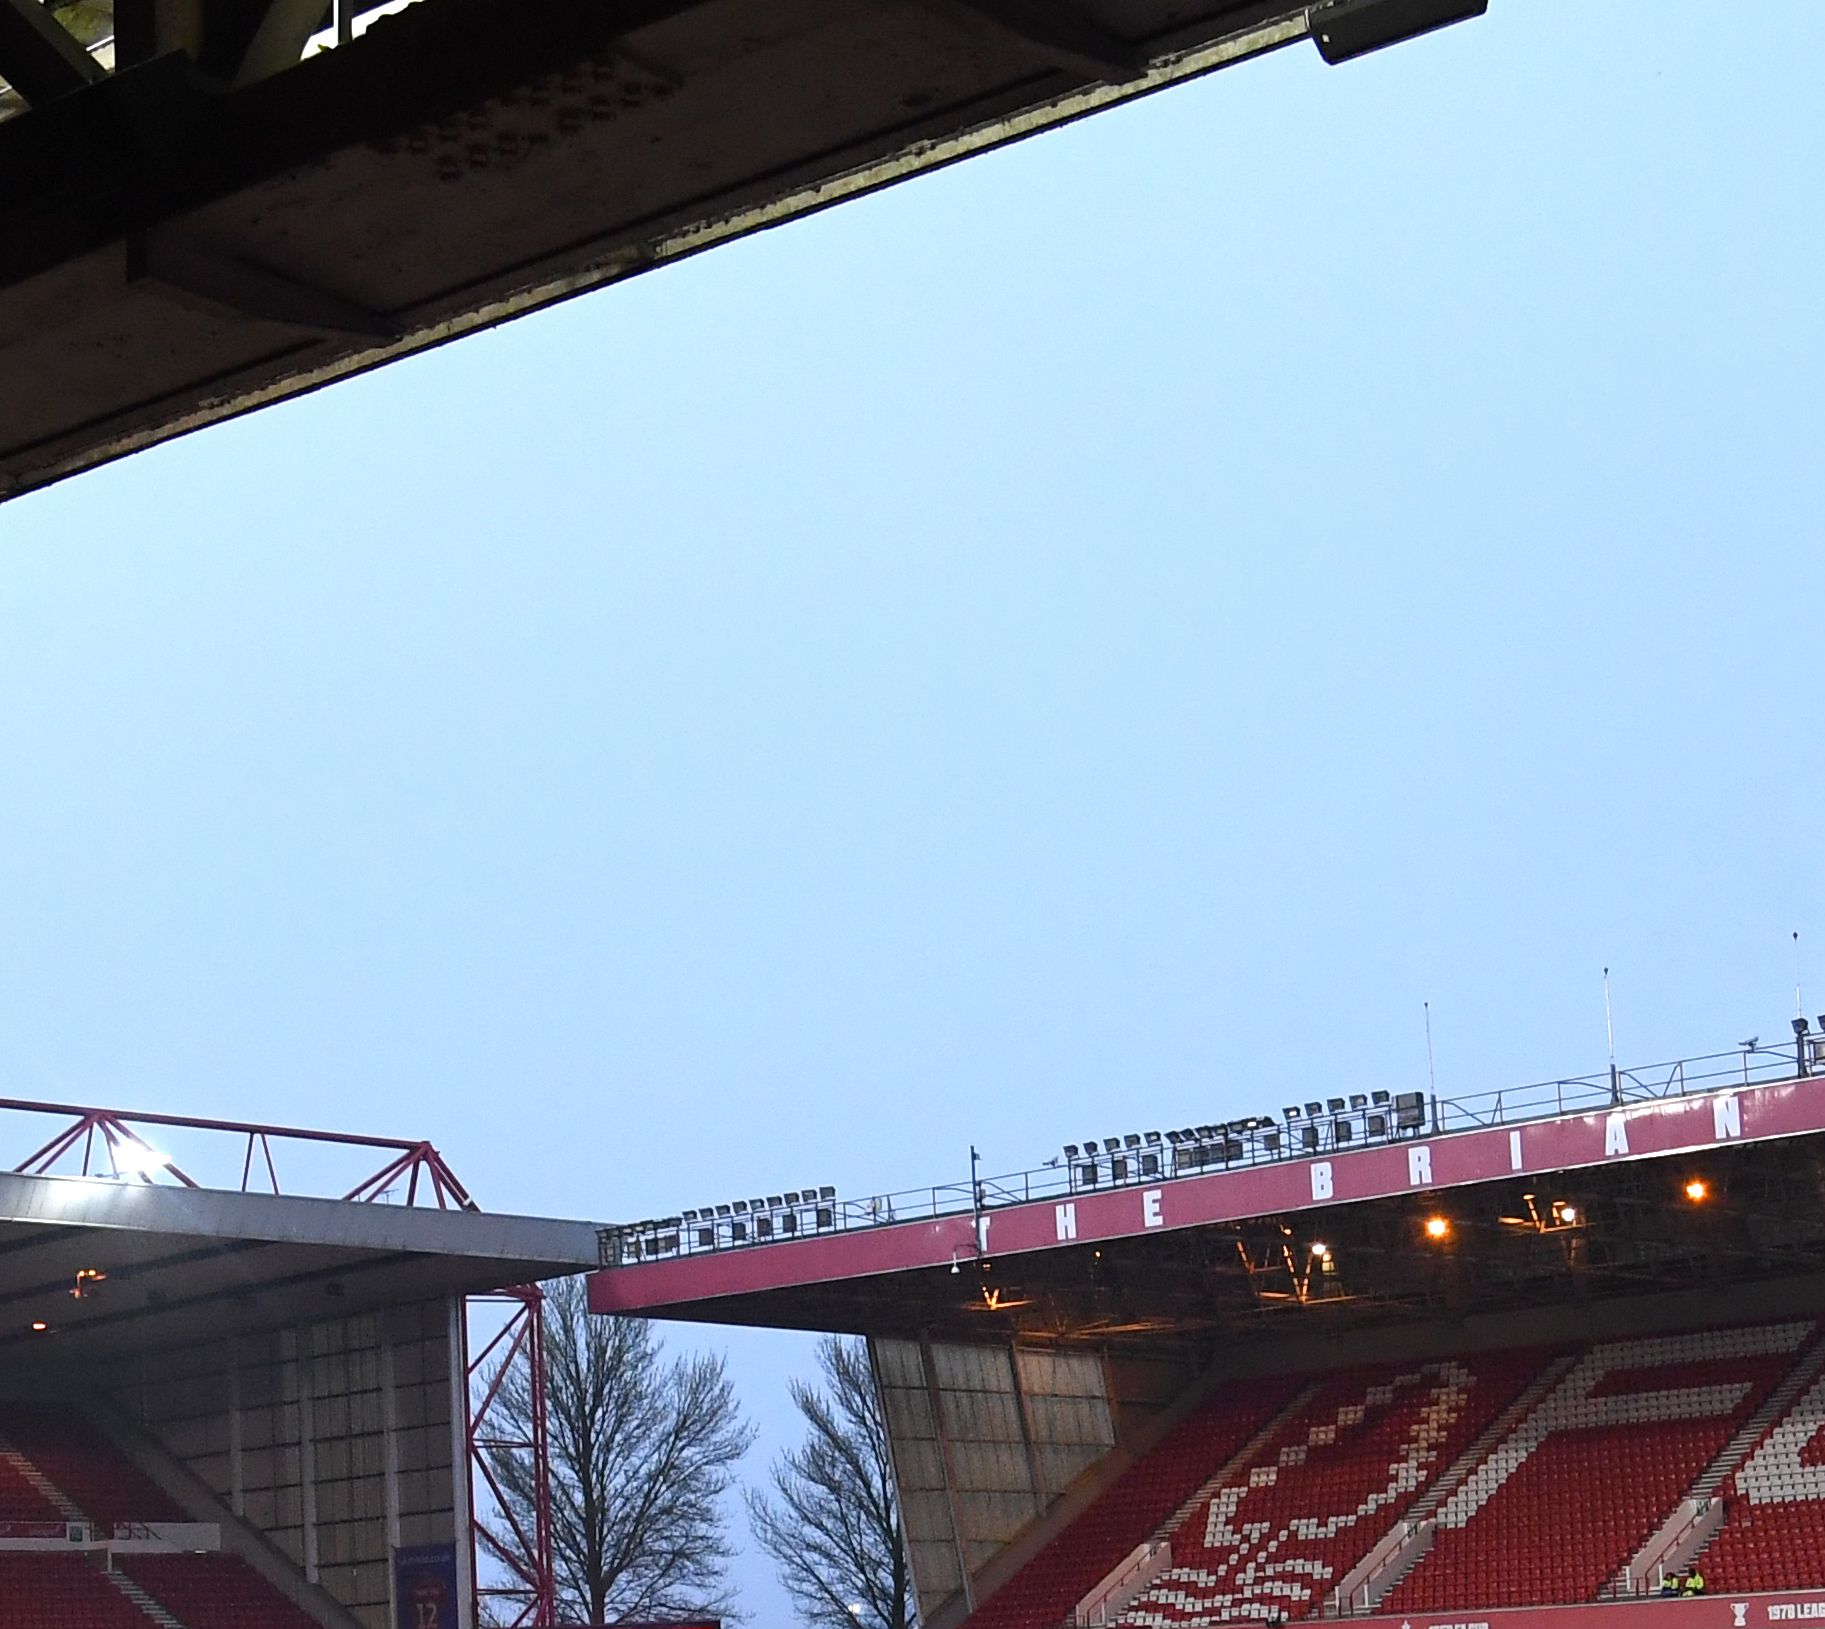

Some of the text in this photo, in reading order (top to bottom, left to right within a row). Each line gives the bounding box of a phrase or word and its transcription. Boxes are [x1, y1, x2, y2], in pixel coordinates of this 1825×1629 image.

[976, 1188, 1164, 1254] THE
[1310, 1095, 1743, 1201] BRIAN
[416, 1602, 438, 1629] 12
